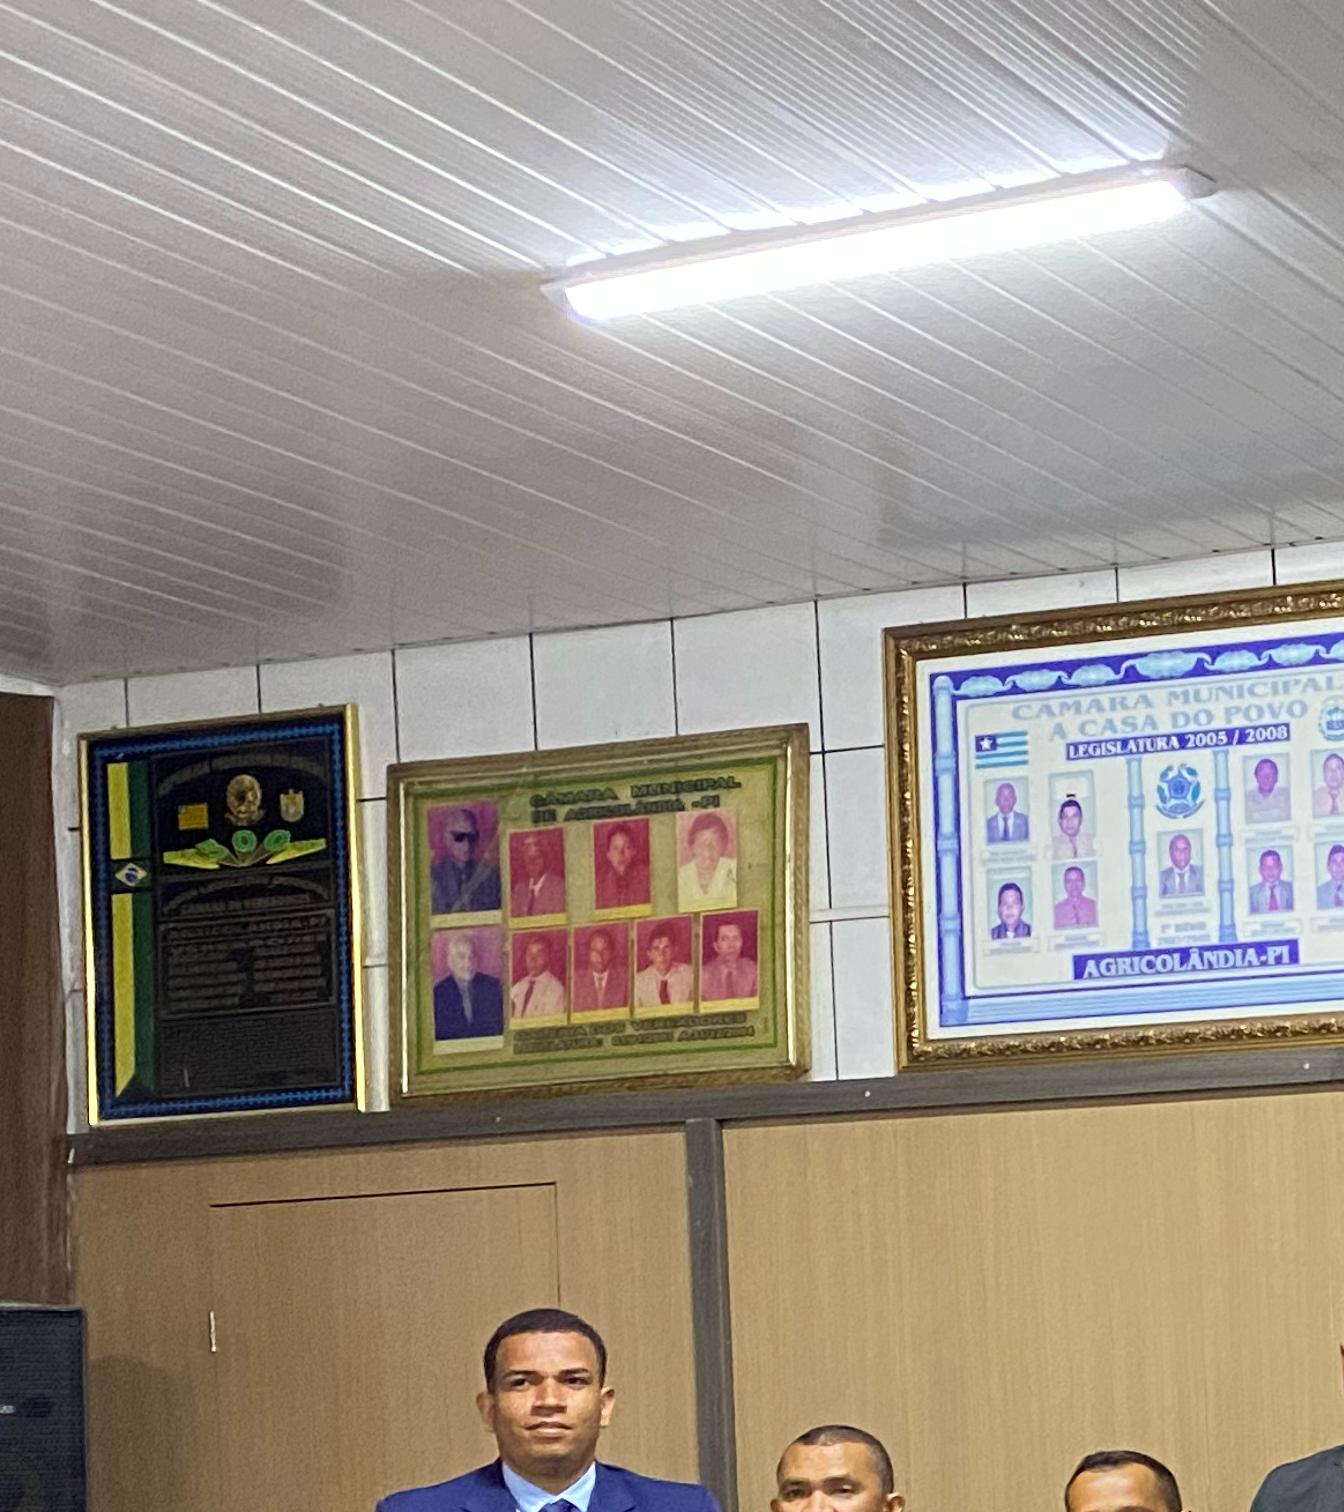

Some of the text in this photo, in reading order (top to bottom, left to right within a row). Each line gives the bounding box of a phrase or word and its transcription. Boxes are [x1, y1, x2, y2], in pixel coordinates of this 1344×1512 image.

[1167, 675, 1344, 706] MUNICIPAL
[1050, 699, 1310, 741] A CASA DO POVO
[1068, 724, 1288, 760] LEGISLATURA 2005 / 2008
[630, 775, 743, 799] MUNICIPAL
[1083, 946, 1291, 979] AGRICOLÂNDIA-PI
